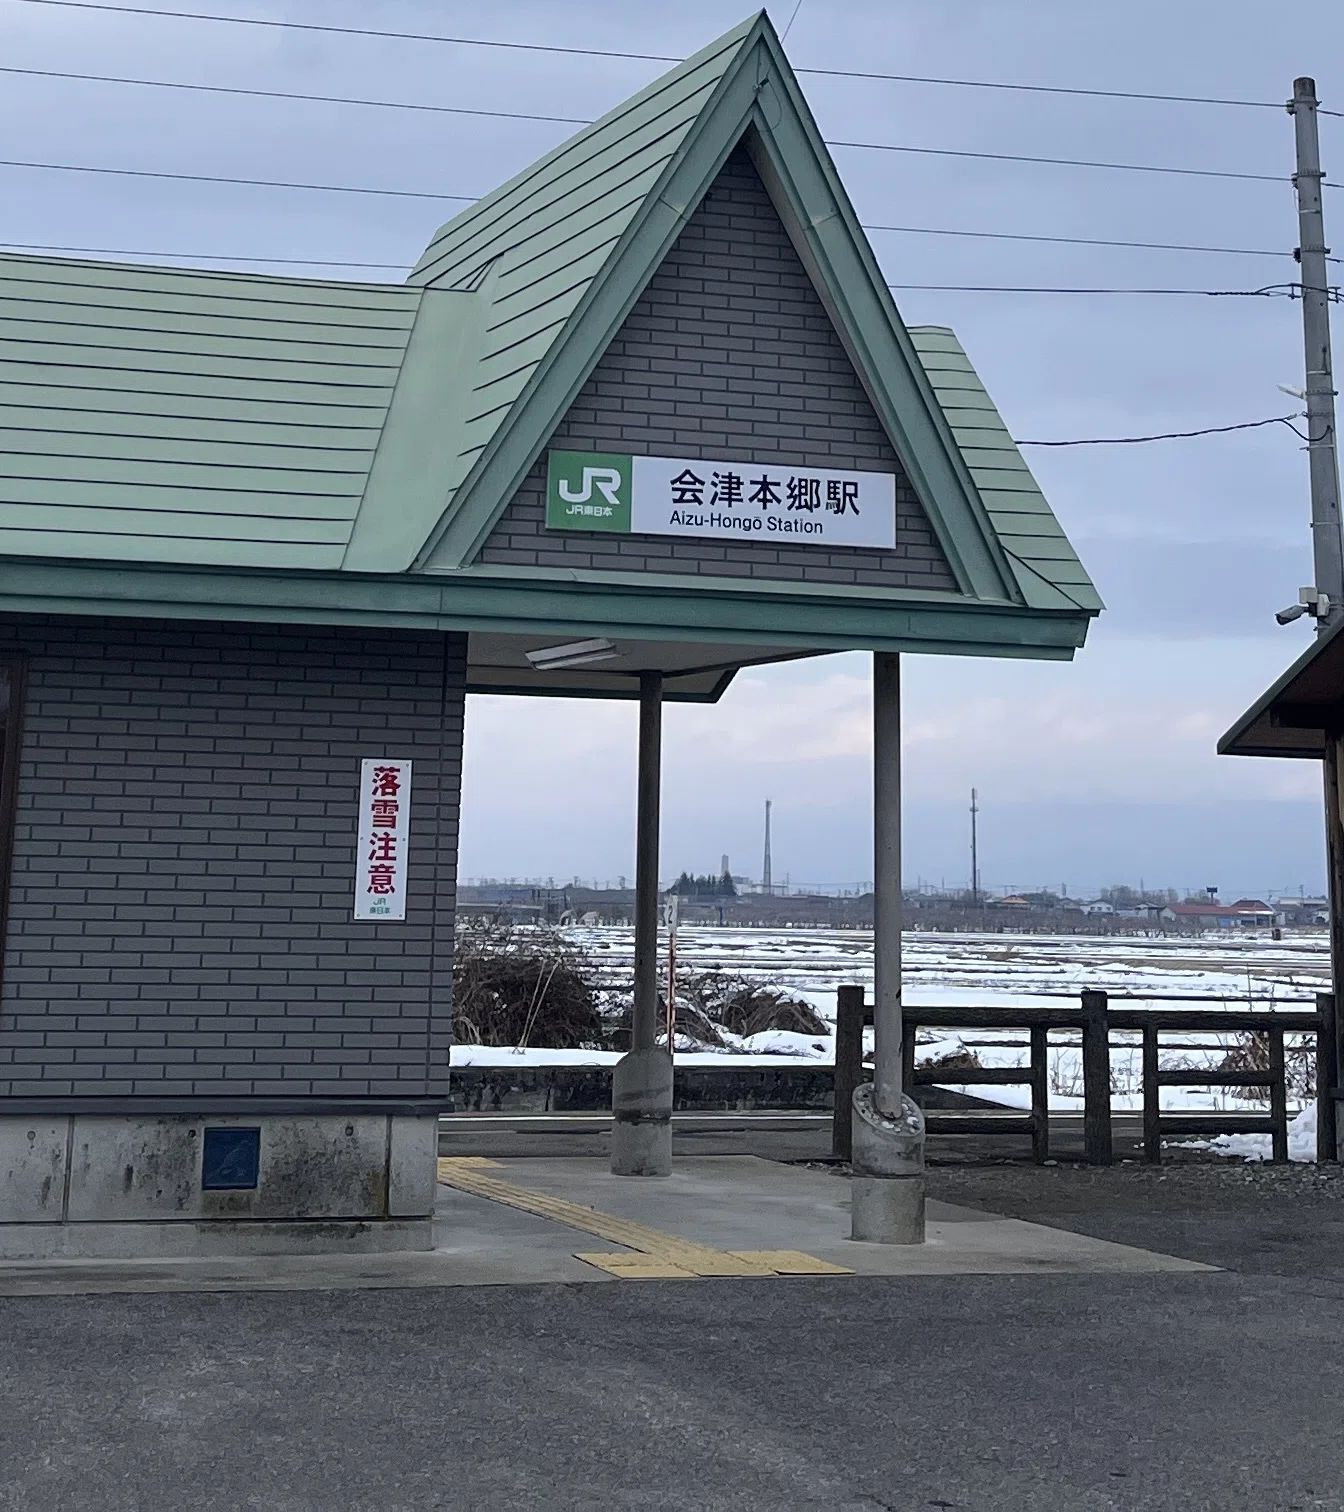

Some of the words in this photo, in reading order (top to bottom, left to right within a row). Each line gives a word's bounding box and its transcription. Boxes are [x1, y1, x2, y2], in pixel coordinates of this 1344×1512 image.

[559, 467, 621, 504] JR
[669, 468, 861, 516] 会津本郷駅
[565, 504, 613, 517] JR東日本
[767, 516, 824, 534] Station
[367, 766, 402, 895] 落雪注意
